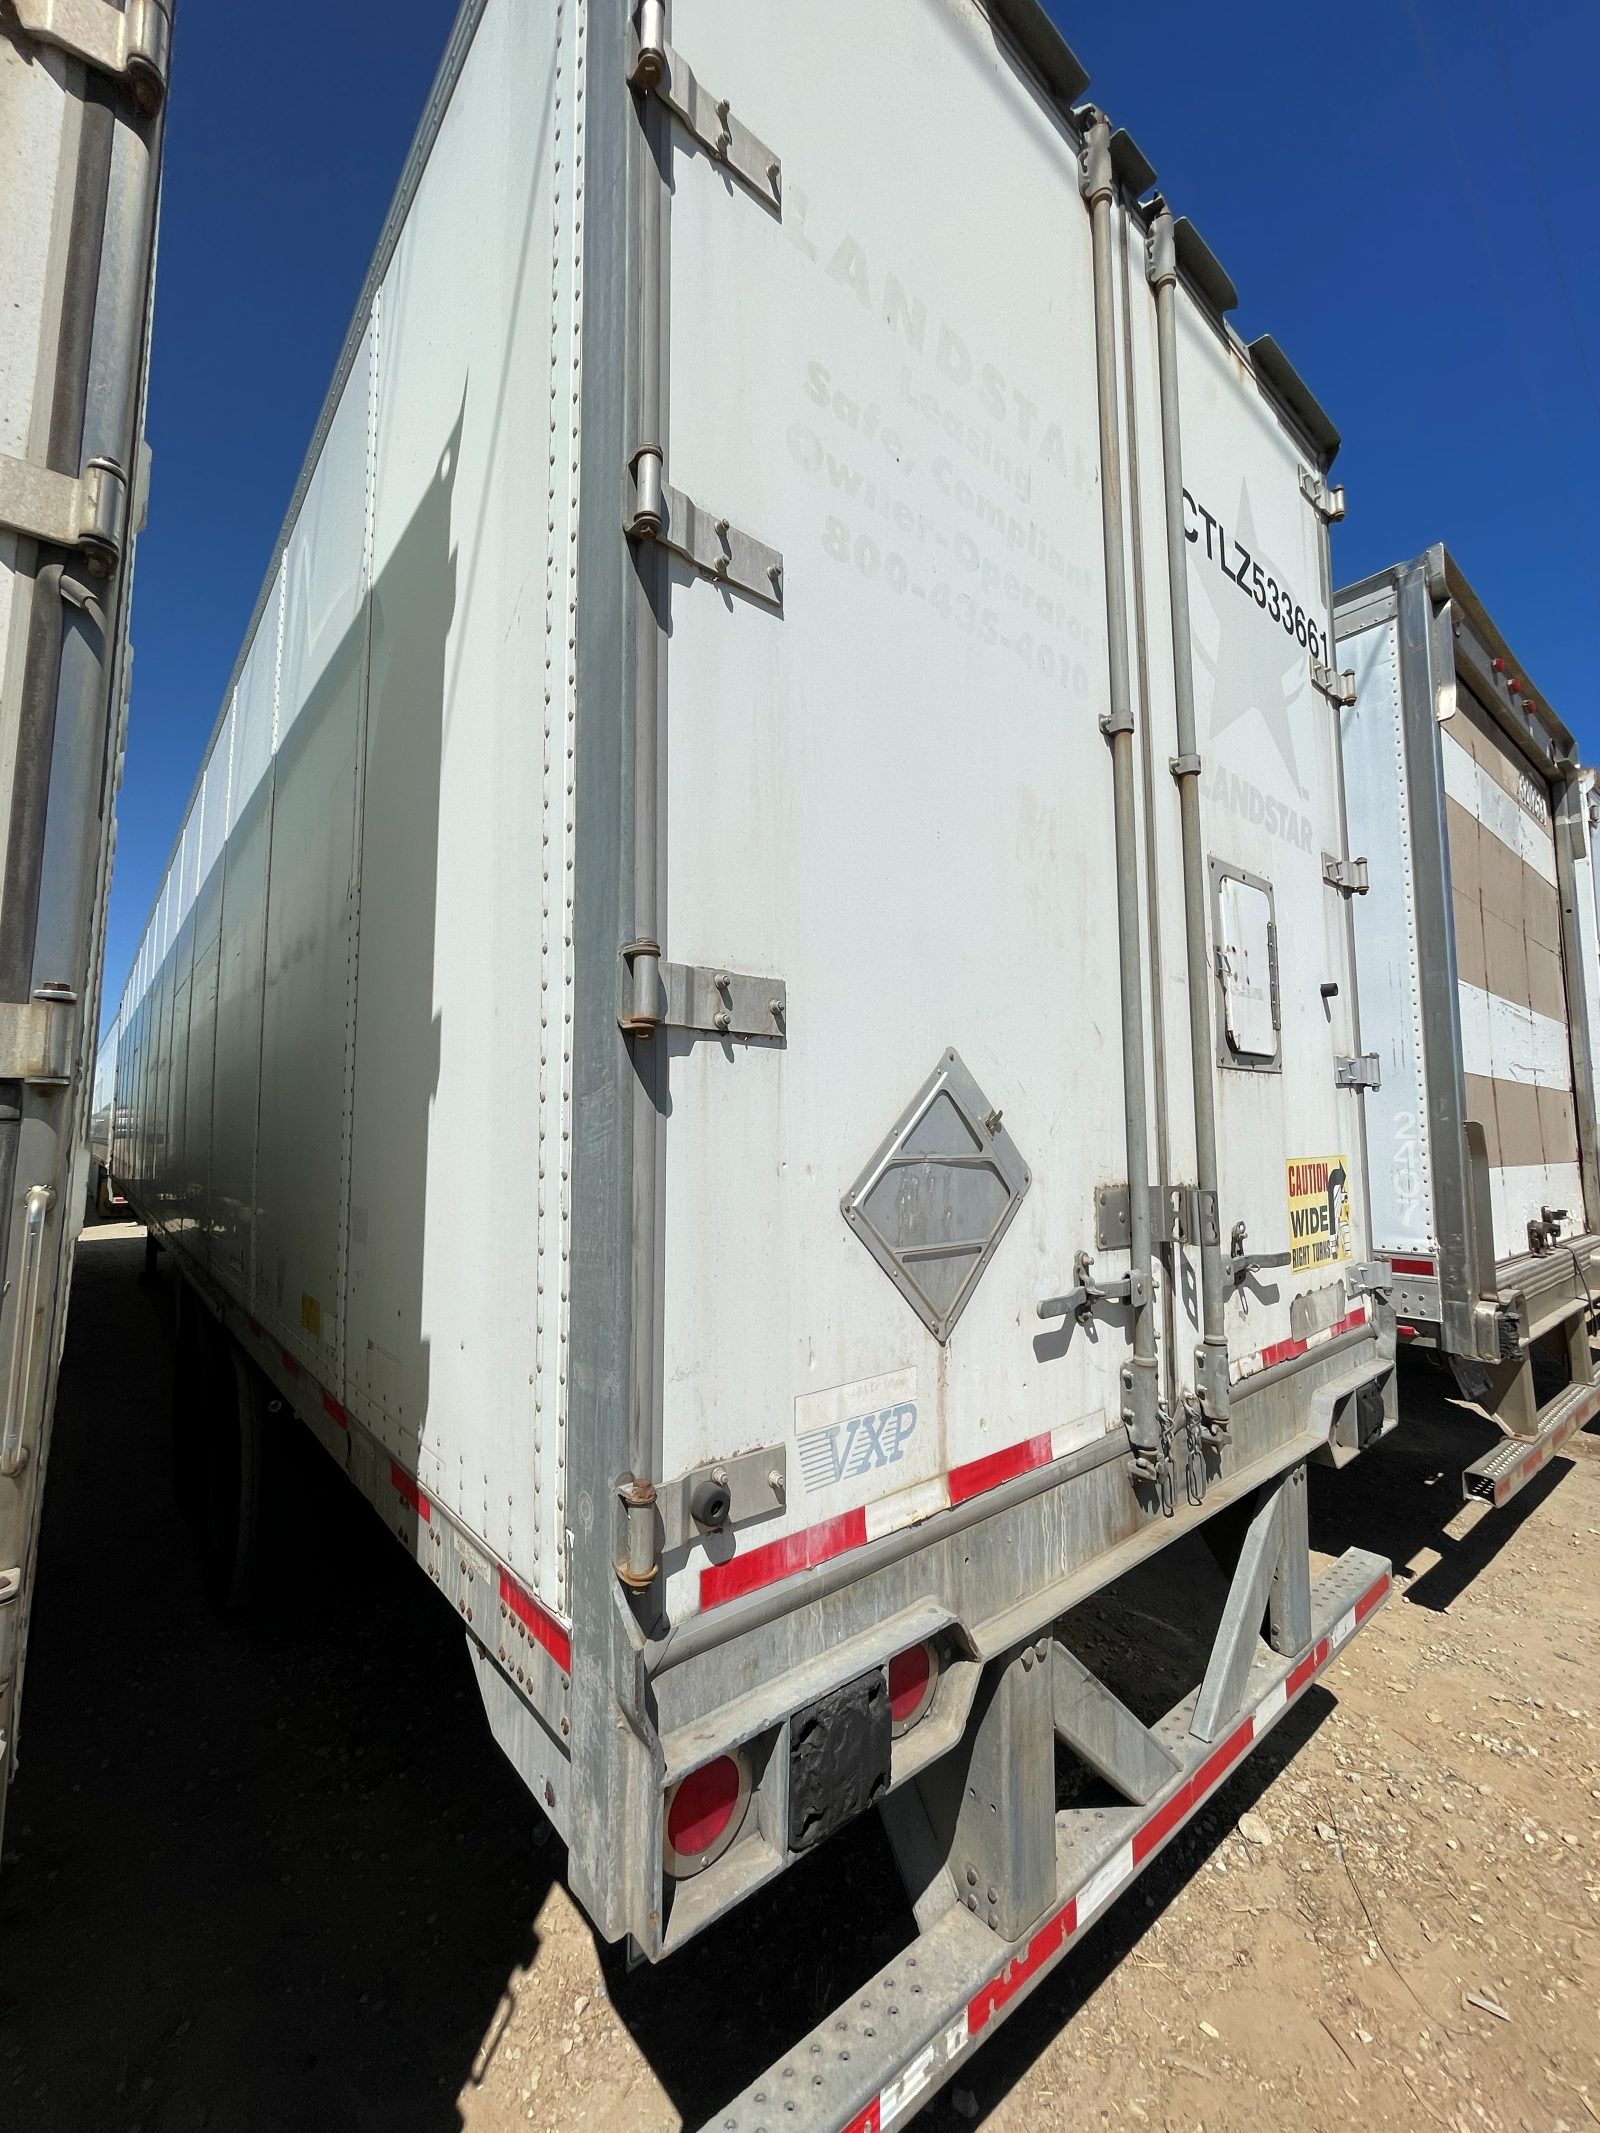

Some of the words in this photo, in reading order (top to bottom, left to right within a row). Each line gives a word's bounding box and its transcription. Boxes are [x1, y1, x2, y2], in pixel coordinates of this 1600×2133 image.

[899, 363, 1032, 504] Leasing
[1182, 487, 1329, 668] CTLZ533661
[1288, 1163, 1328, 1197] CAUTION
[1291, 1205, 1328, 1238] WIDE
[1292, 1245, 1309, 1268] RIGHT
[1312, 1240, 1331, 1262] TURNS
[826, 1403, 917, 1483] VXP
